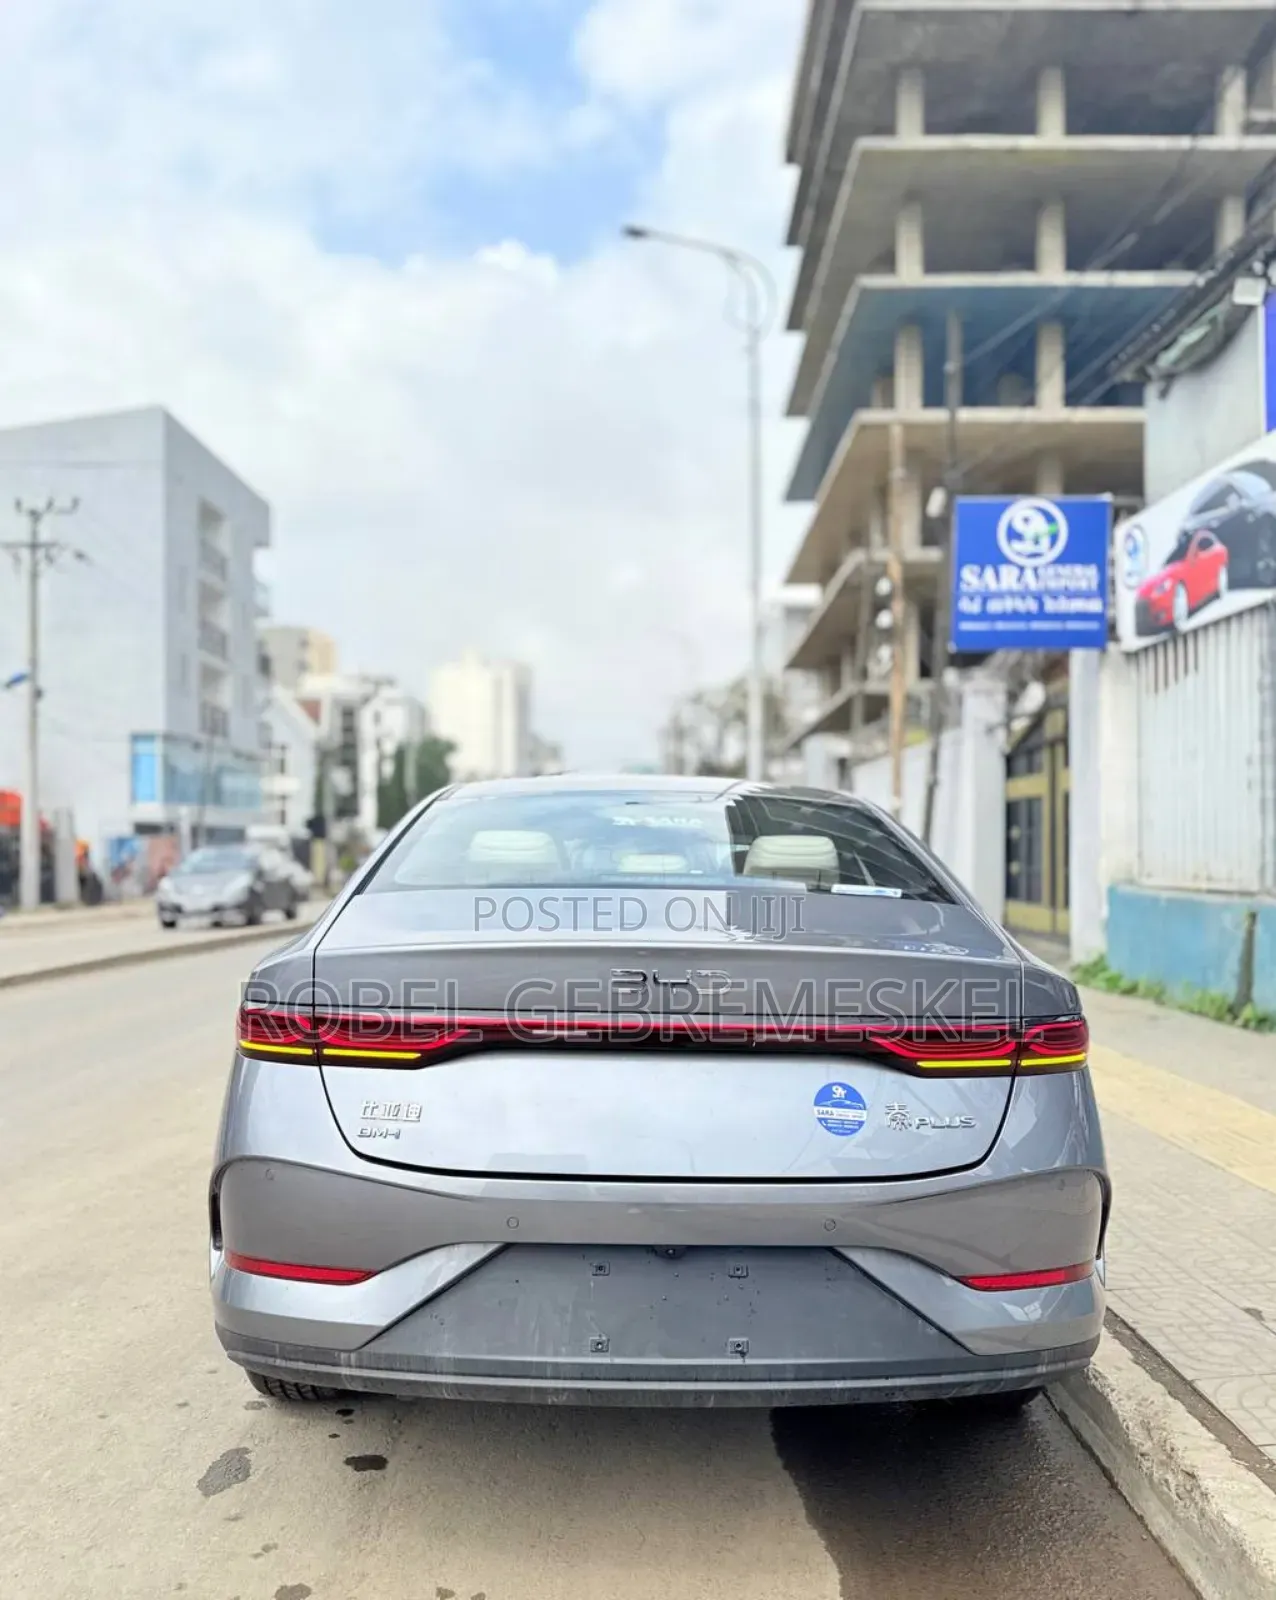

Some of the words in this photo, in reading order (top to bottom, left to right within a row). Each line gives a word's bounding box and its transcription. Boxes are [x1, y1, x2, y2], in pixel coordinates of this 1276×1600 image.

[960, 564, 1038, 592] SARA
[609, 967, 732, 994] BYD
[360, 1100, 422, 1122] 比亚迪
